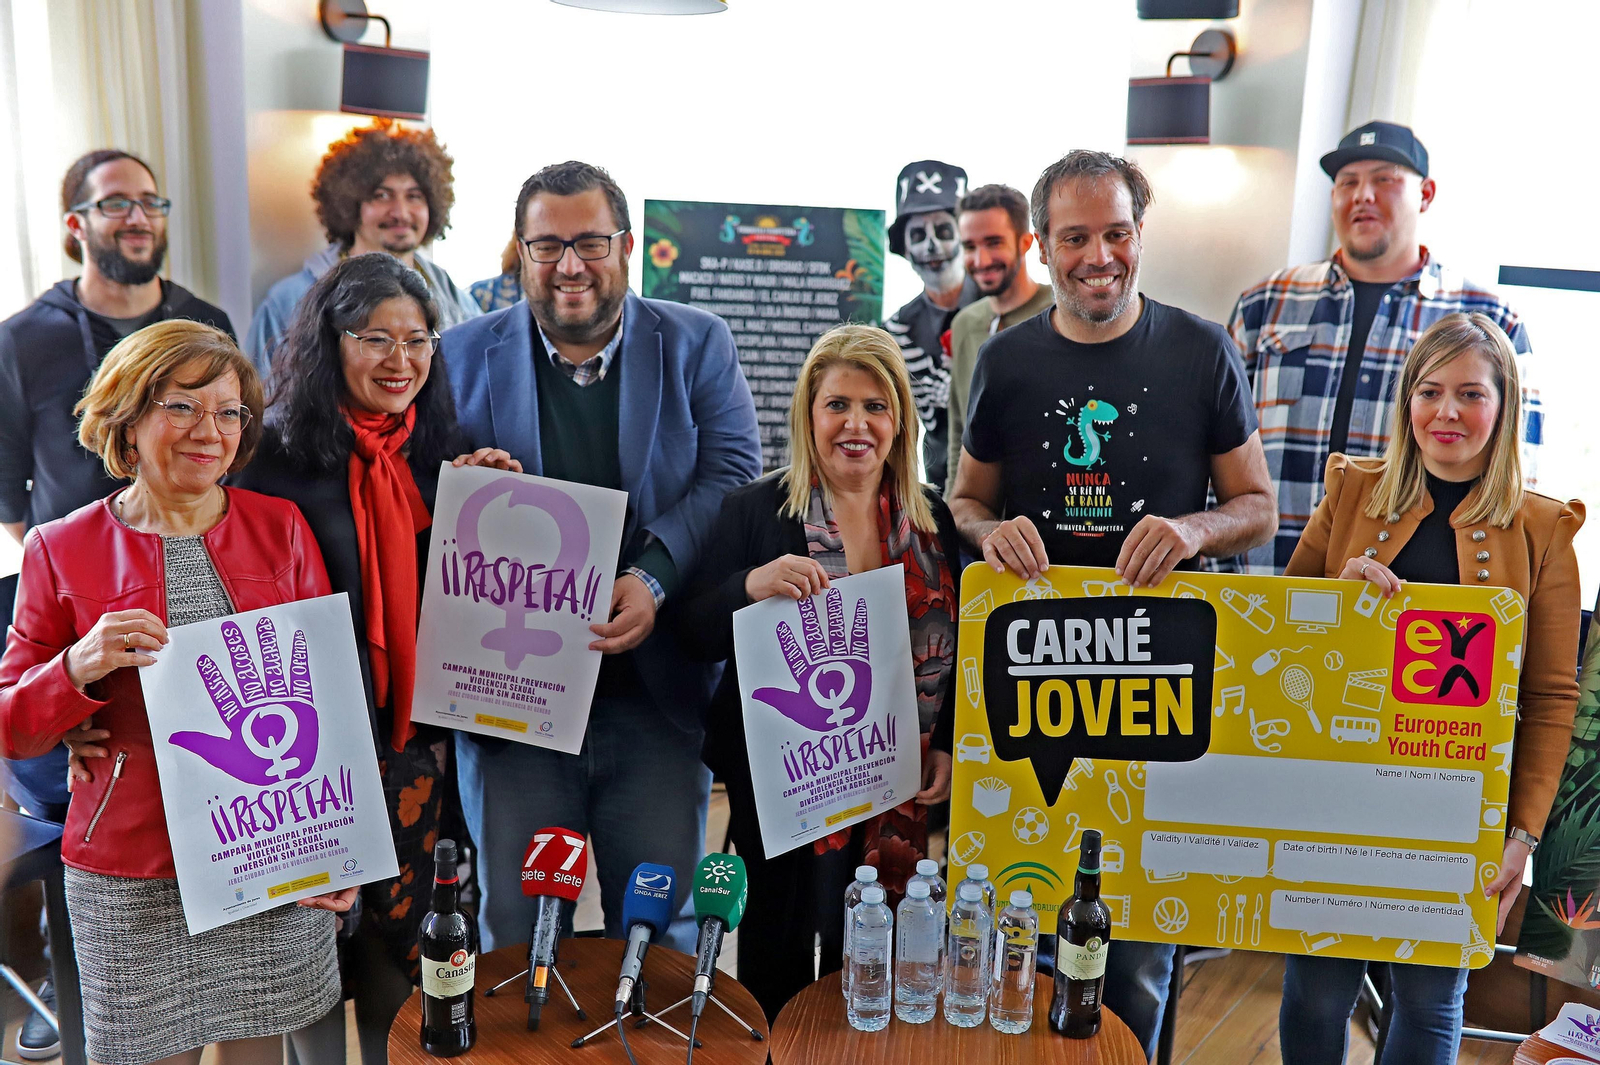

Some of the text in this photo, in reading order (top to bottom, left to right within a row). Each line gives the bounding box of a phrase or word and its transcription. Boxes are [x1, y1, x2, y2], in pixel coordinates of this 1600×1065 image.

[1066, 472, 1111, 487] NUNCA
[1064, 495, 1113, 507] SE BAILA
[1069, 485, 1106, 496] SE RÍE NI
[1065, 507, 1113, 518] SUFICIENTE
[1056, 523, 1124, 532] PRIMAVERA TROMPETERA
[441, 539, 602, 621] ¡¡RESPETA!!
[1006, 608, 1151, 664] CARNÉ
[810, 642, 829, 659] NO
[832, 640, 847, 655] NO
[852, 640, 868, 657] NO
[442, 662, 566, 693] CAMPAÑA MUNICIPAL PREVENCIÓN
[792, 659, 807, 678] NO
[243, 681, 265, 701] NO
[269, 679, 288, 697] NO
[293, 679, 312, 699] NO
[455, 681, 547, 706] DIVERSIÓN SIN AGRESIÓN
[469, 675, 536, 696] VIOLENCIA SEXUAL
[221, 700, 240, 722] NO
[1008, 677, 1194, 737] JOVEN
[1394, 713, 1482, 738] European
[780, 712, 897, 784] ¡¡RESPETA!!
[1387, 736, 1487, 761] Youth Card
[782, 755, 896, 798] CAMPAÑA MUNICIPAL PREVENCIÓN
[809, 771, 870, 796] VIOLENCIA SEXUAL
[1375, 769, 1476, 783] Name Nom Nombre
[835, 786, 848, 796] SIN
[207, 764, 355, 845] ¡¡RESPETA!!
[211, 815, 355, 863] CAMPAÑA MUNICIPAL PREVENCIÓN
[246, 833, 323, 861] VIOLENCIA SEXUAL
[1150, 833, 1259, 849] Validity Validité Validez
[233, 838, 340, 875] DIVERSIÓN SIN AGRESIÓN
[290, 853, 319, 867] VIOLENCIA
[524, 833, 586, 871] 7 7
[1283, 842, 1469, 864] Date of birth Né le Fecha de nacimiento
[521, 870, 583, 888] siete siete
[634, 889, 668, 900] ONDA JEREZ
[1284, 894, 1464, 916] Number Numéro Número de identidad
